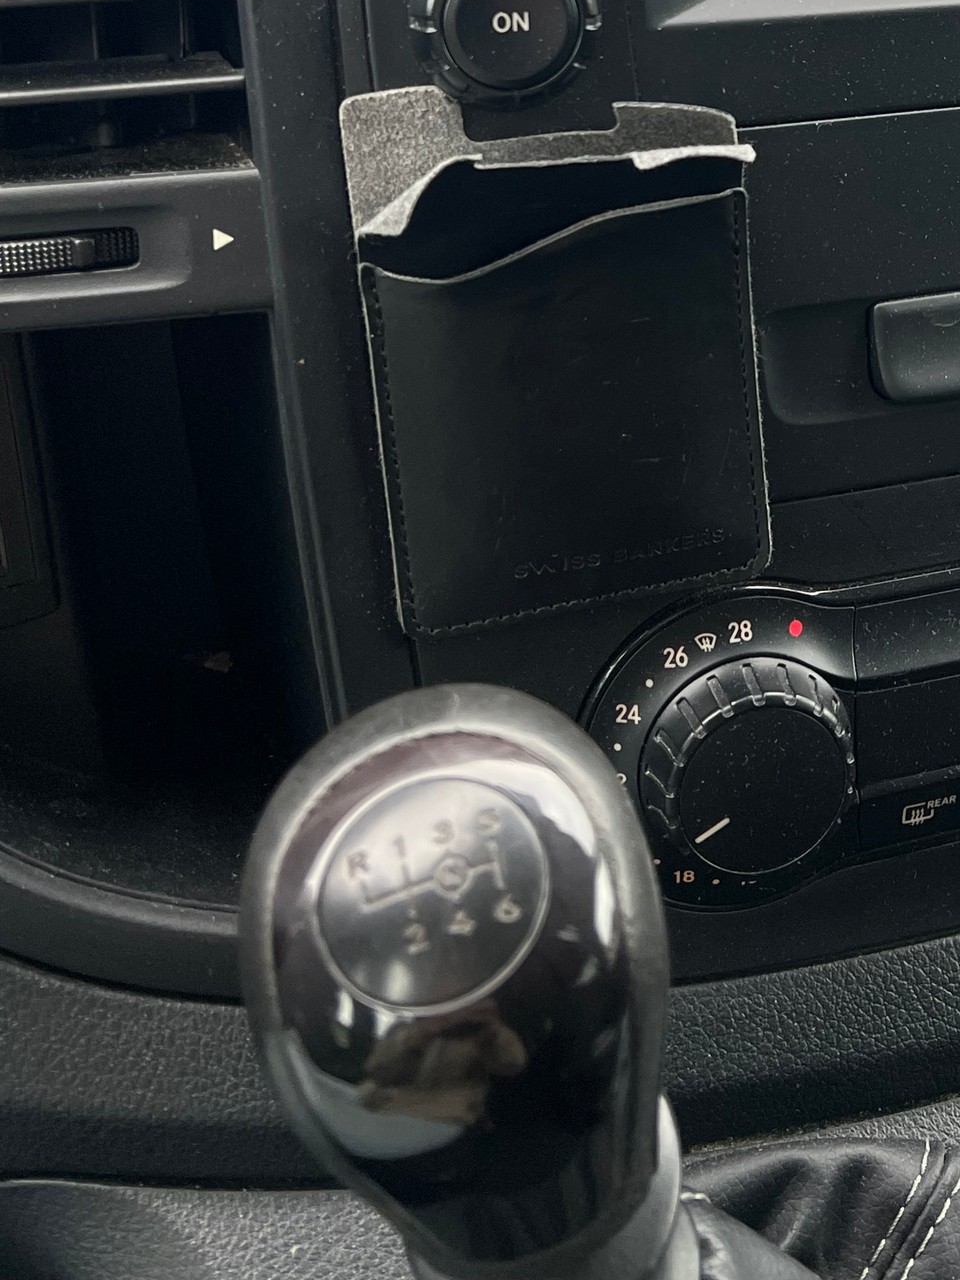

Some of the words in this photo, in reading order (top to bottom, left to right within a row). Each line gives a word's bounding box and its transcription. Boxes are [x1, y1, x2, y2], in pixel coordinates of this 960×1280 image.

[491, 10, 530, 34] ON
[513, 553, 602, 580] SWISS
[727, 620, 753, 644] 28
[663, 647, 689, 669] 26
[614, 702, 643, 726] 24
[926, 794, 957, 809] REAR
[673, 869, 696, 884] 18
[401, 921, 432, 956] 2
[490, 892, 523, 924] 6
